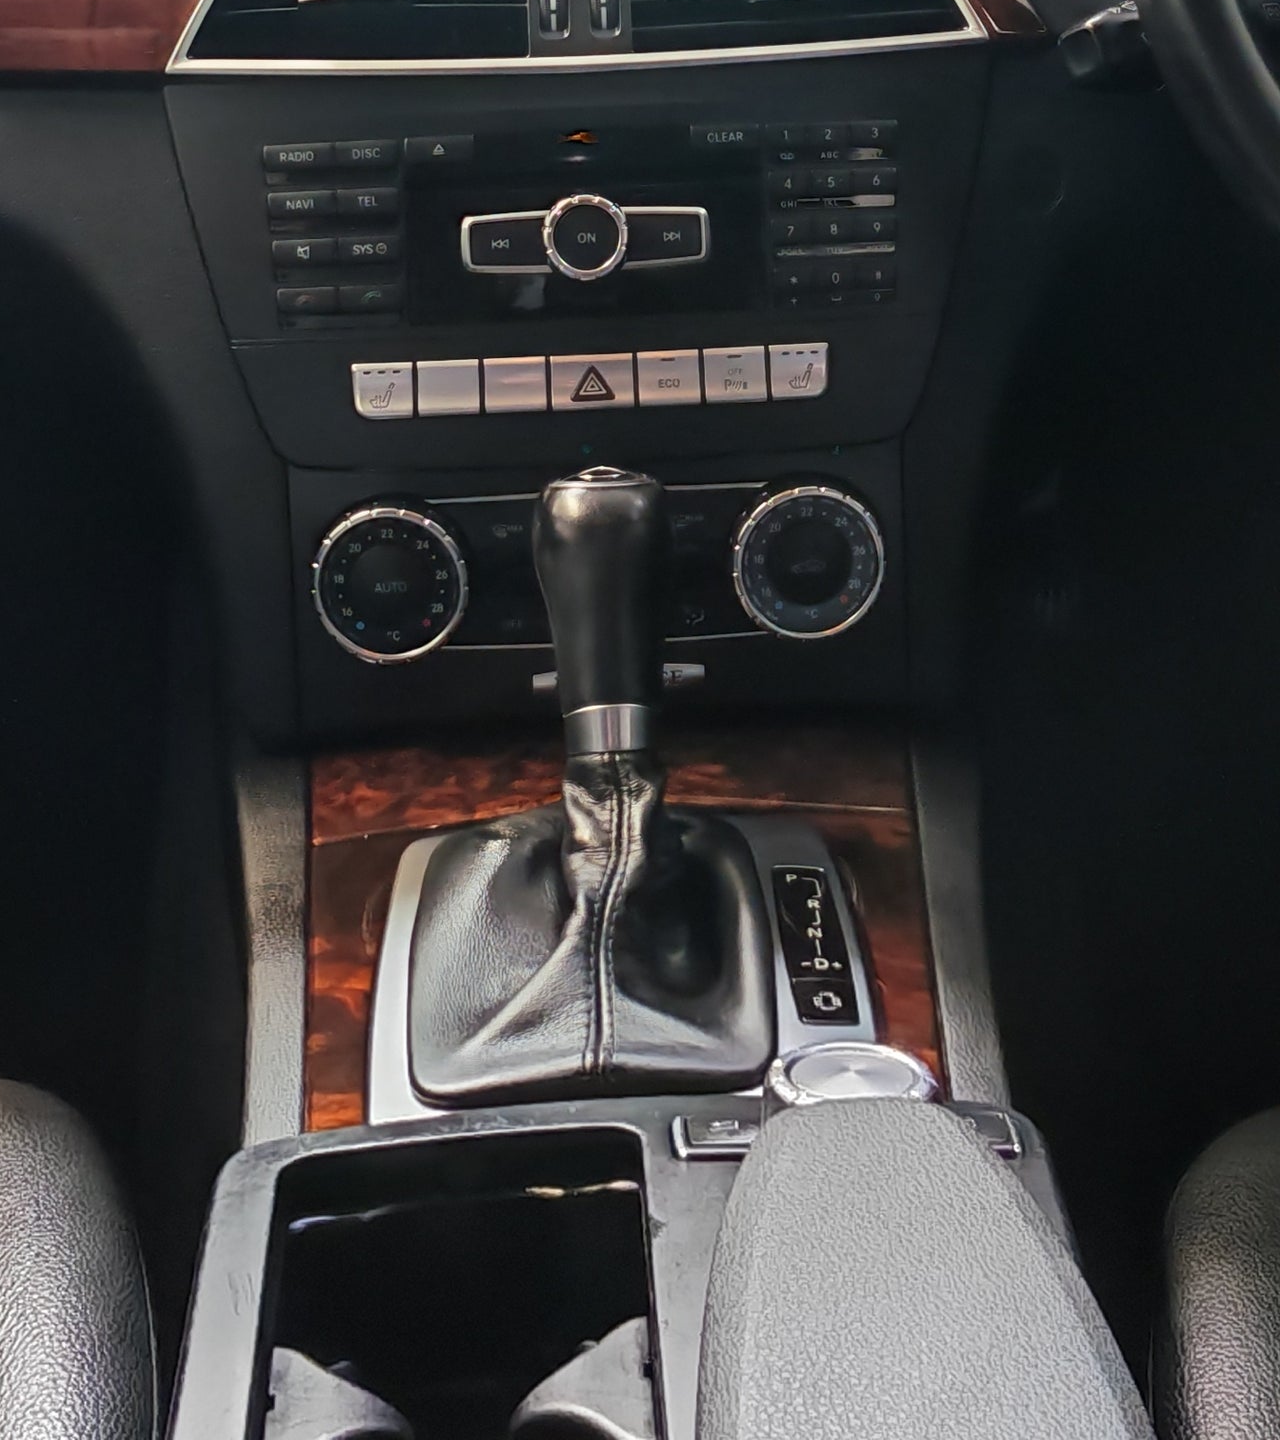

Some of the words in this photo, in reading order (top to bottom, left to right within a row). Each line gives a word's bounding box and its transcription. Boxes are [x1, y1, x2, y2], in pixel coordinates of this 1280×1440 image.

[706, 131, 744, 143] CLEAR
[783, 130, 789, 140] 1
[825, 129, 832, 140] 2
[871, 127, 879, 138] 3
[279, 151, 315, 162] RADIO
[352, 147, 381, 159] DISC
[820, 151, 840, 160] ABC
[784, 178, 792, 189] 4
[827, 176, 836, 187] 5
[872, 174, 880, 186] 6
[286, 198, 315, 210] NAVI
[357, 195, 379, 207] TEL
[787, 226, 795, 237] 7
[830, 224, 838, 235] 8
[873, 222, 881, 233] 9
[577, 233, 596, 244] ON
[352, 244, 374, 255] SYS
[831, 272, 840, 284] 0
[657, 378, 680, 389] ECO
[800, 506, 814, 517] 22
[770, 521, 782, 532] 20
[834, 517, 848, 527] 24
[381, 529, 394, 539] 22
[348, 543, 362, 553] 20
[416, 540, 430, 550] 24
[852, 545, 866, 556] 26
[333, 574, 345, 584] 18
[435, 570, 448, 580] 26
[374, 582, 408, 593] AUTO
[342, 607, 353, 617] 16
[431, 603, 444, 613] 28
[786, 873, 798, 883] P
[807, 898, 821, 908] R
[807, 927, 823, 938] N
[813, 957, 830, 970] D
